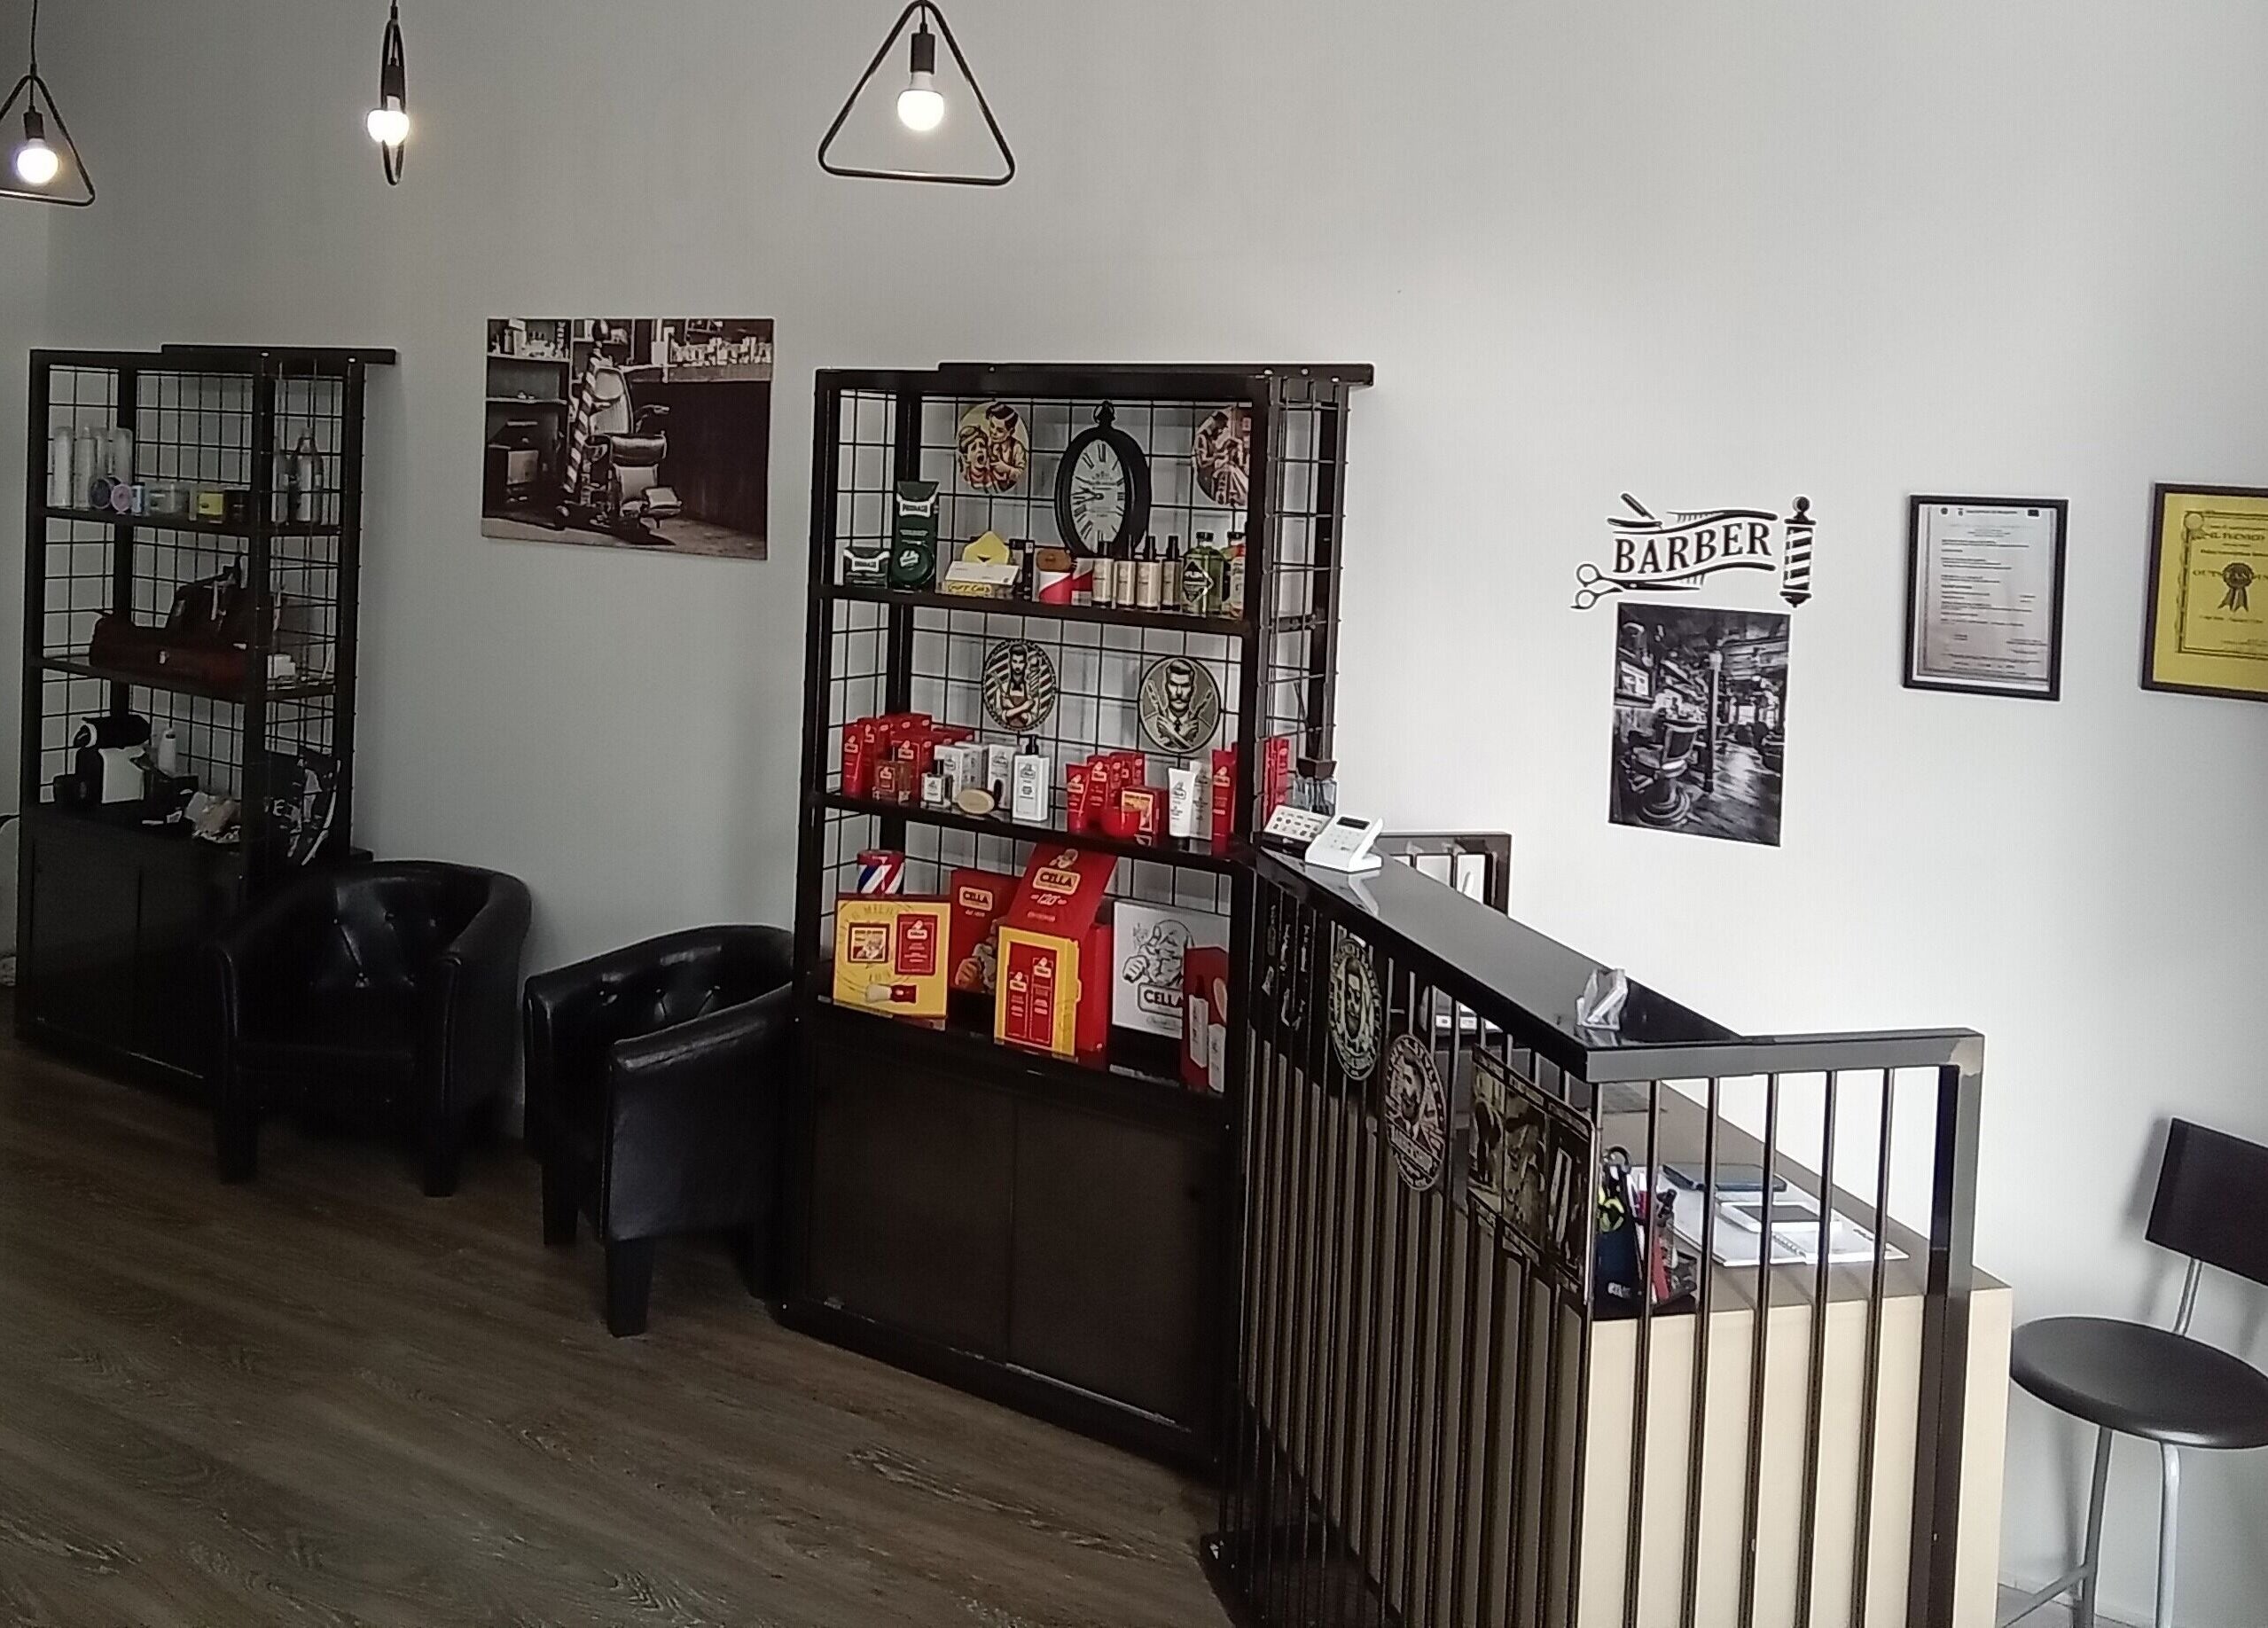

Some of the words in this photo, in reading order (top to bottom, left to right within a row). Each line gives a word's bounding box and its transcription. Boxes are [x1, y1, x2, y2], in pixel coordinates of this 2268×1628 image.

[1612, 521, 1772, 575] BARBER
[1039, 872, 1073, 888] CELLA
[1143, 989, 1184, 1008] CELLA
